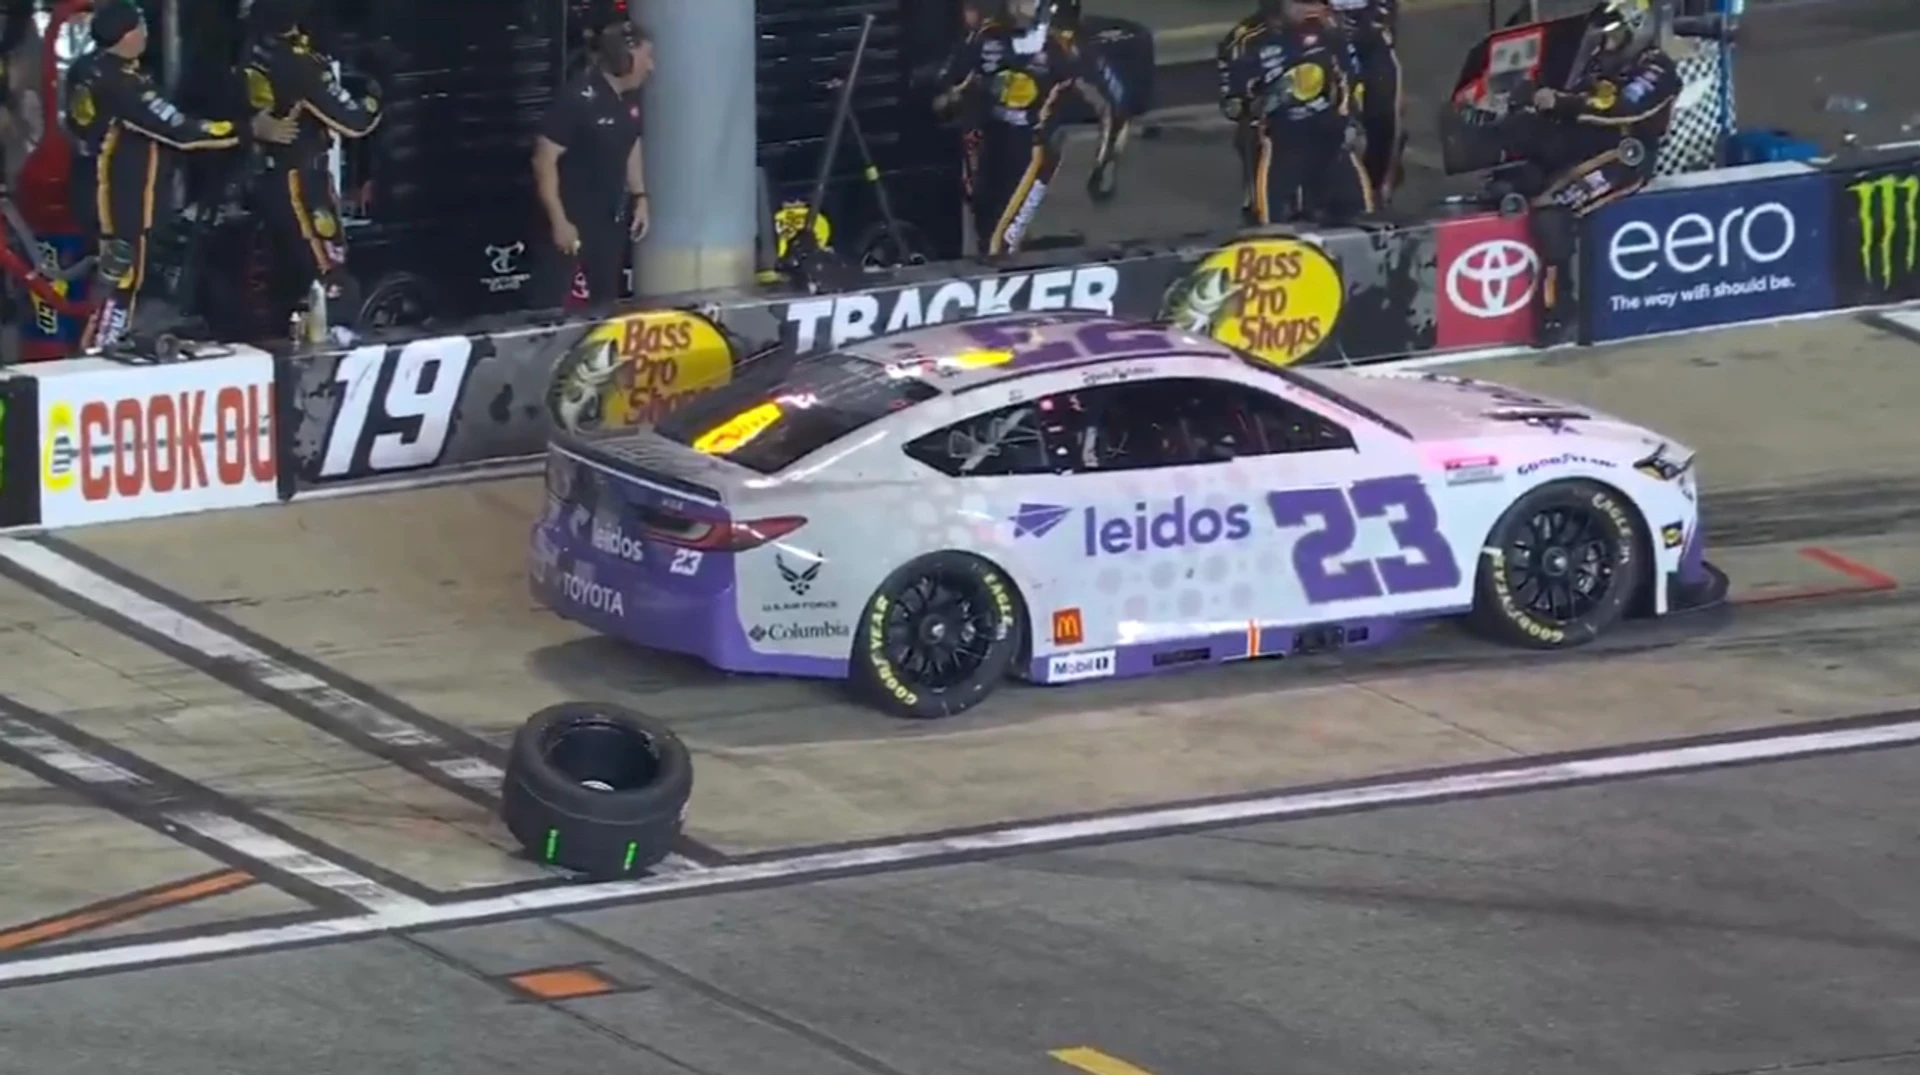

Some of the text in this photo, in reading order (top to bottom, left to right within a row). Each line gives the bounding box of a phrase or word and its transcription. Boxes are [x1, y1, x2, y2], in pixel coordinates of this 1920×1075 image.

[1233, 246, 1303, 283] Bass
[1609, 202, 1796, 281] eero
[787, 265, 1119, 355] TRACKER
[1235, 282, 1288, 318] Pro
[1611, 274, 1796, 312] The way wifi should be.
[622, 318, 693, 356] Bass
[1240, 315, 1321, 356] Shops
[624, 354, 678, 389] Pro
[319, 335, 473, 477] 19
[79, 390, 209, 501] COOK
[591, 516, 645, 563] leidos
[1084, 494, 1252, 557] leidos
[1266, 474, 1462, 606] 23
[668, 547, 704, 577] 23
[562, 571, 625, 618] TOYOTA
[983, 572, 1015, 627] EAGLE
[767, 620, 850, 641] Columbia
[868, 593, 919, 706] GOODYEAR
[1053, 657, 1094, 676] Mobil
